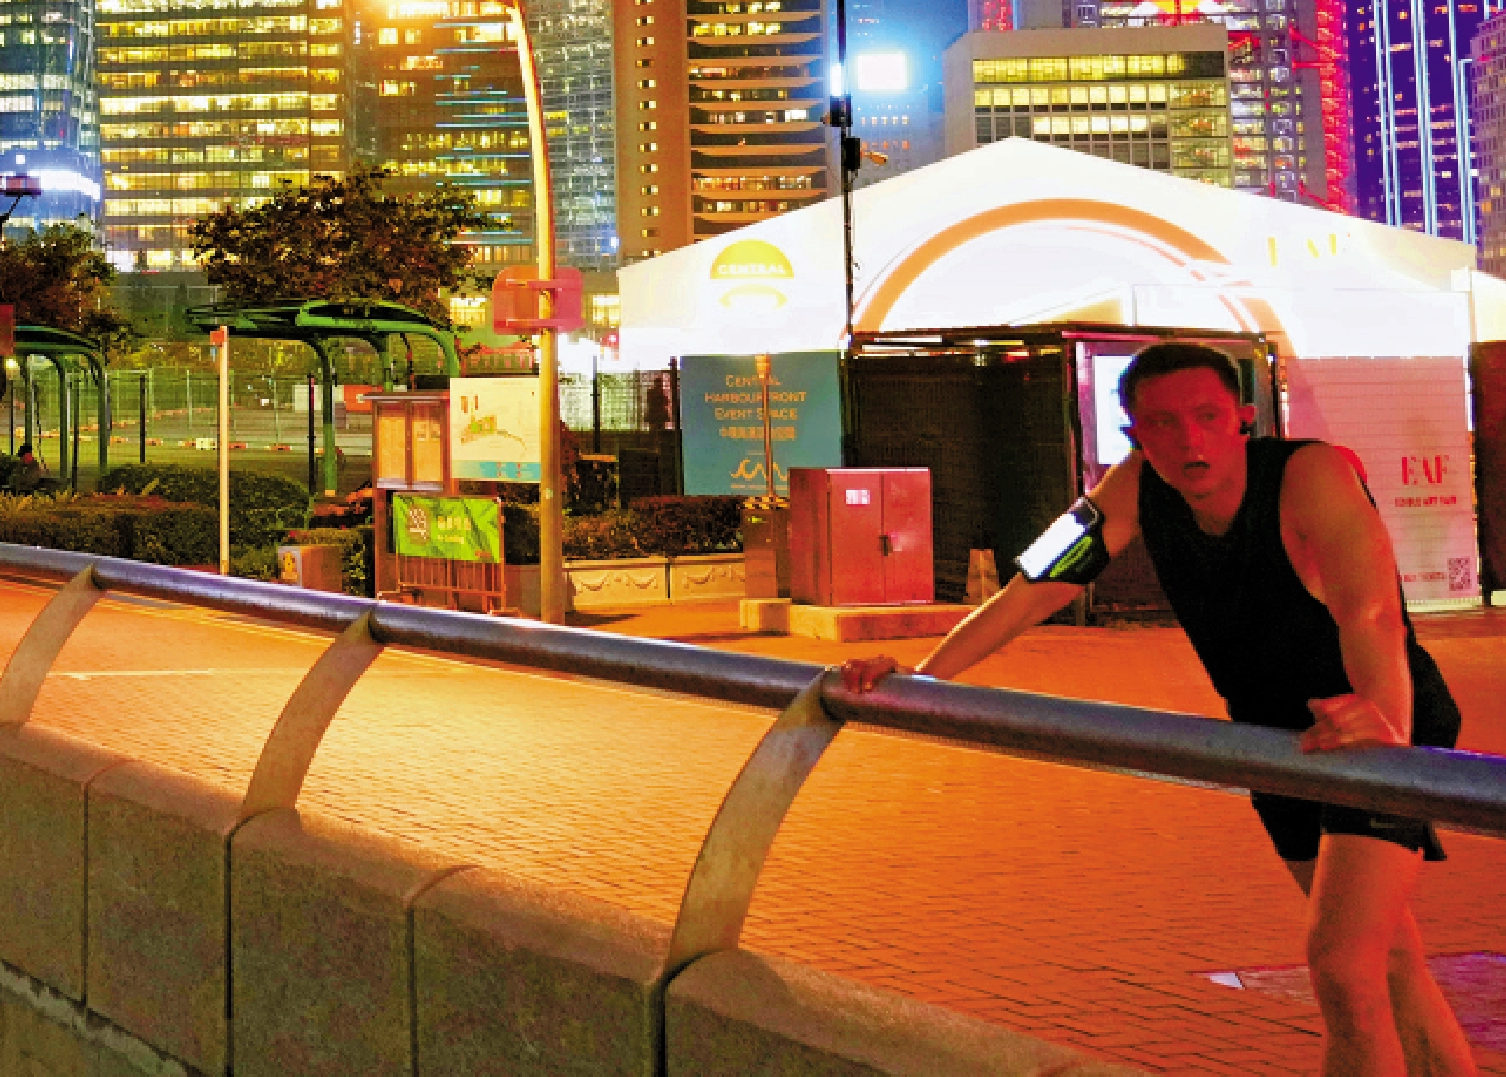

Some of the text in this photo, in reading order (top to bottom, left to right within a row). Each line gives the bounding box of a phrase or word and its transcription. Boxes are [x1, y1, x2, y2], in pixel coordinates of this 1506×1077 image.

[718, 263, 786, 275] CENTRAL
[756, 407, 798, 420] SACE
[1401, 454, 1450, 485] EAF
